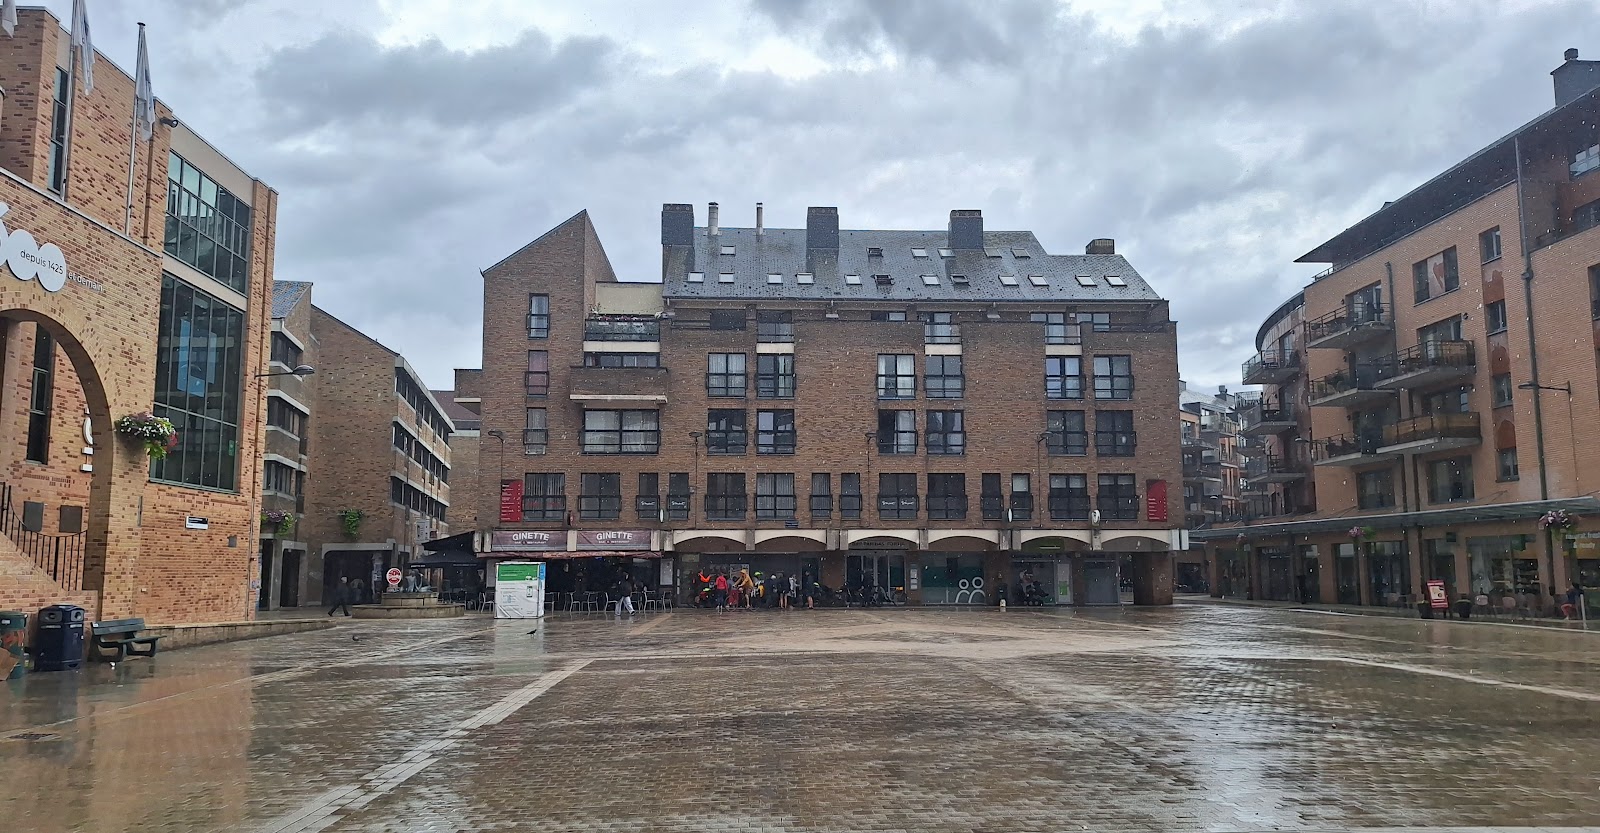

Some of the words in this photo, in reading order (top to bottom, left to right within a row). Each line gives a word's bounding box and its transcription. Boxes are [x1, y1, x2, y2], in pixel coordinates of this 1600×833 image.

[20, 250, 47, 267] depuis
[48, 260, 64, 275] 1425
[68, 271, 76, 281] et
[77, 274, 104, 292] demain
[512, 532, 550, 541] GINETTE
[596, 531, 633, 541] GINETTE
